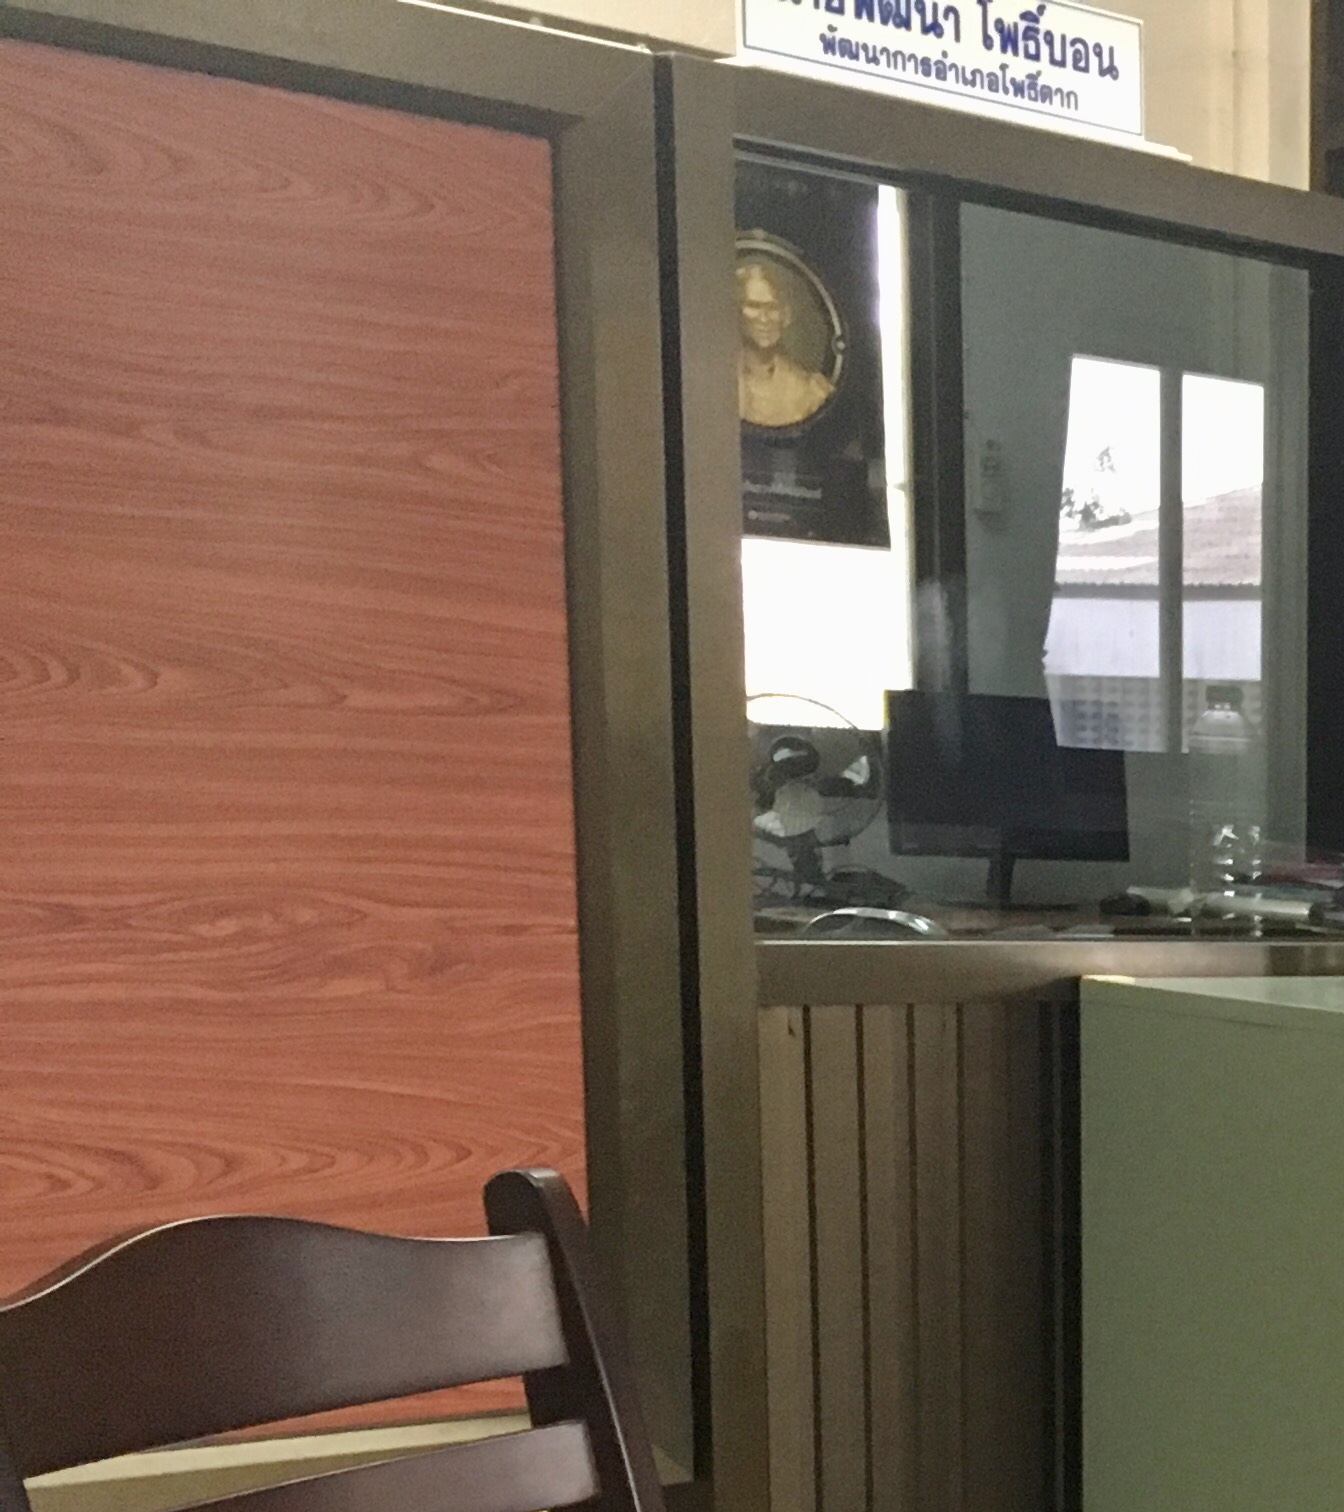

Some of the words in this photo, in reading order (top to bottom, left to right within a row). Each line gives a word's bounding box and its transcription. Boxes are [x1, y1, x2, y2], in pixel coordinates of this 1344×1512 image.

[819, 24, 1079, 111] พัฒนาการอำเภอโพธิ์ตาก
[977, 0, 1120, 81] โพธิ์บอน
